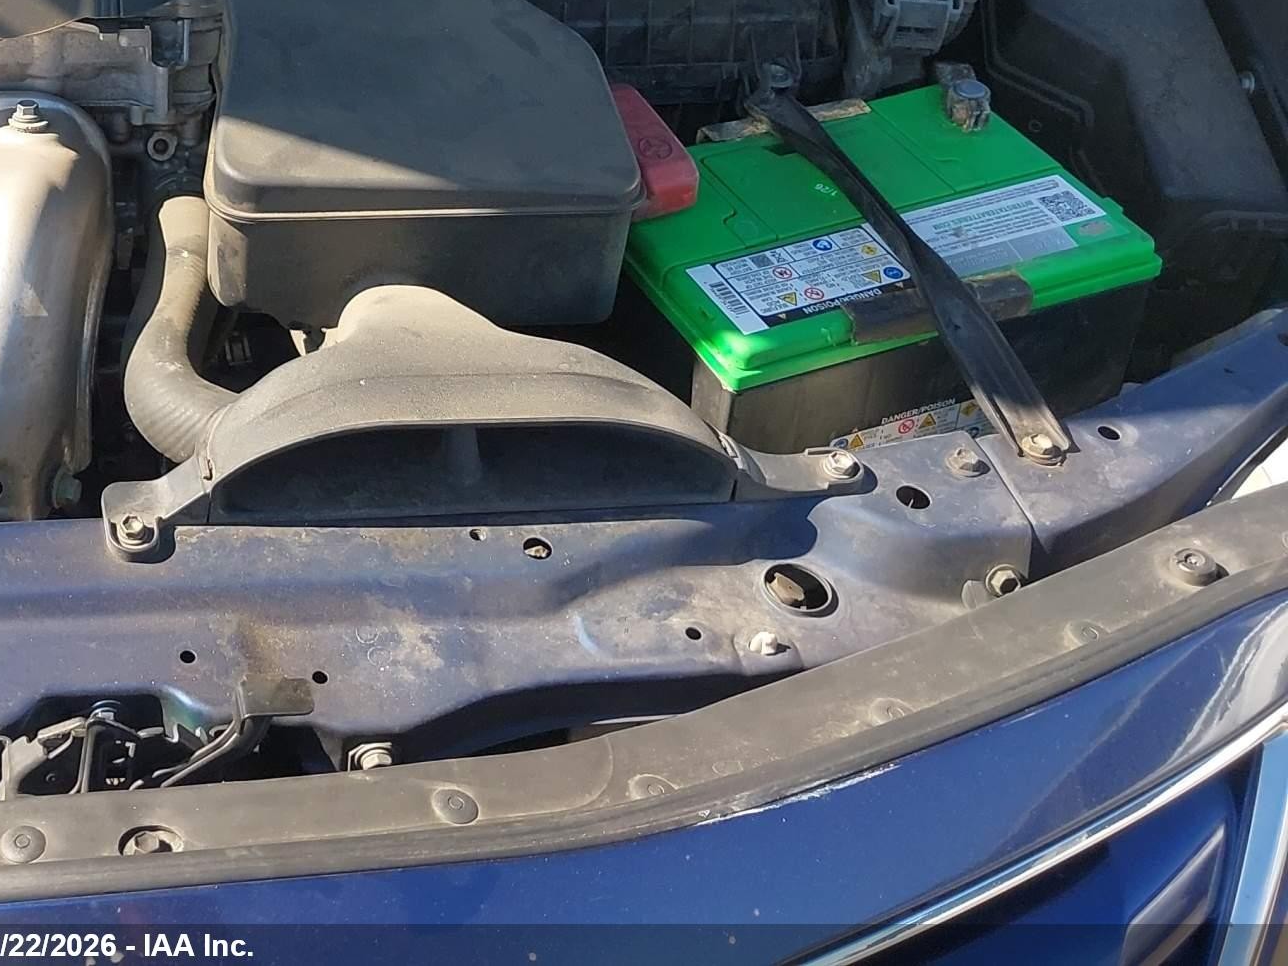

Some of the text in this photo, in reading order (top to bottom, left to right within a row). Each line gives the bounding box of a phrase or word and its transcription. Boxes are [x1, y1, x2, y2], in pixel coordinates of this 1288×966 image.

[814, 182, 838, 197] 1/26
[933, 200, 1034, 231] INTERSTATEBATTERIES.COM
[881, 397, 955, 425] DANGER/POISON
